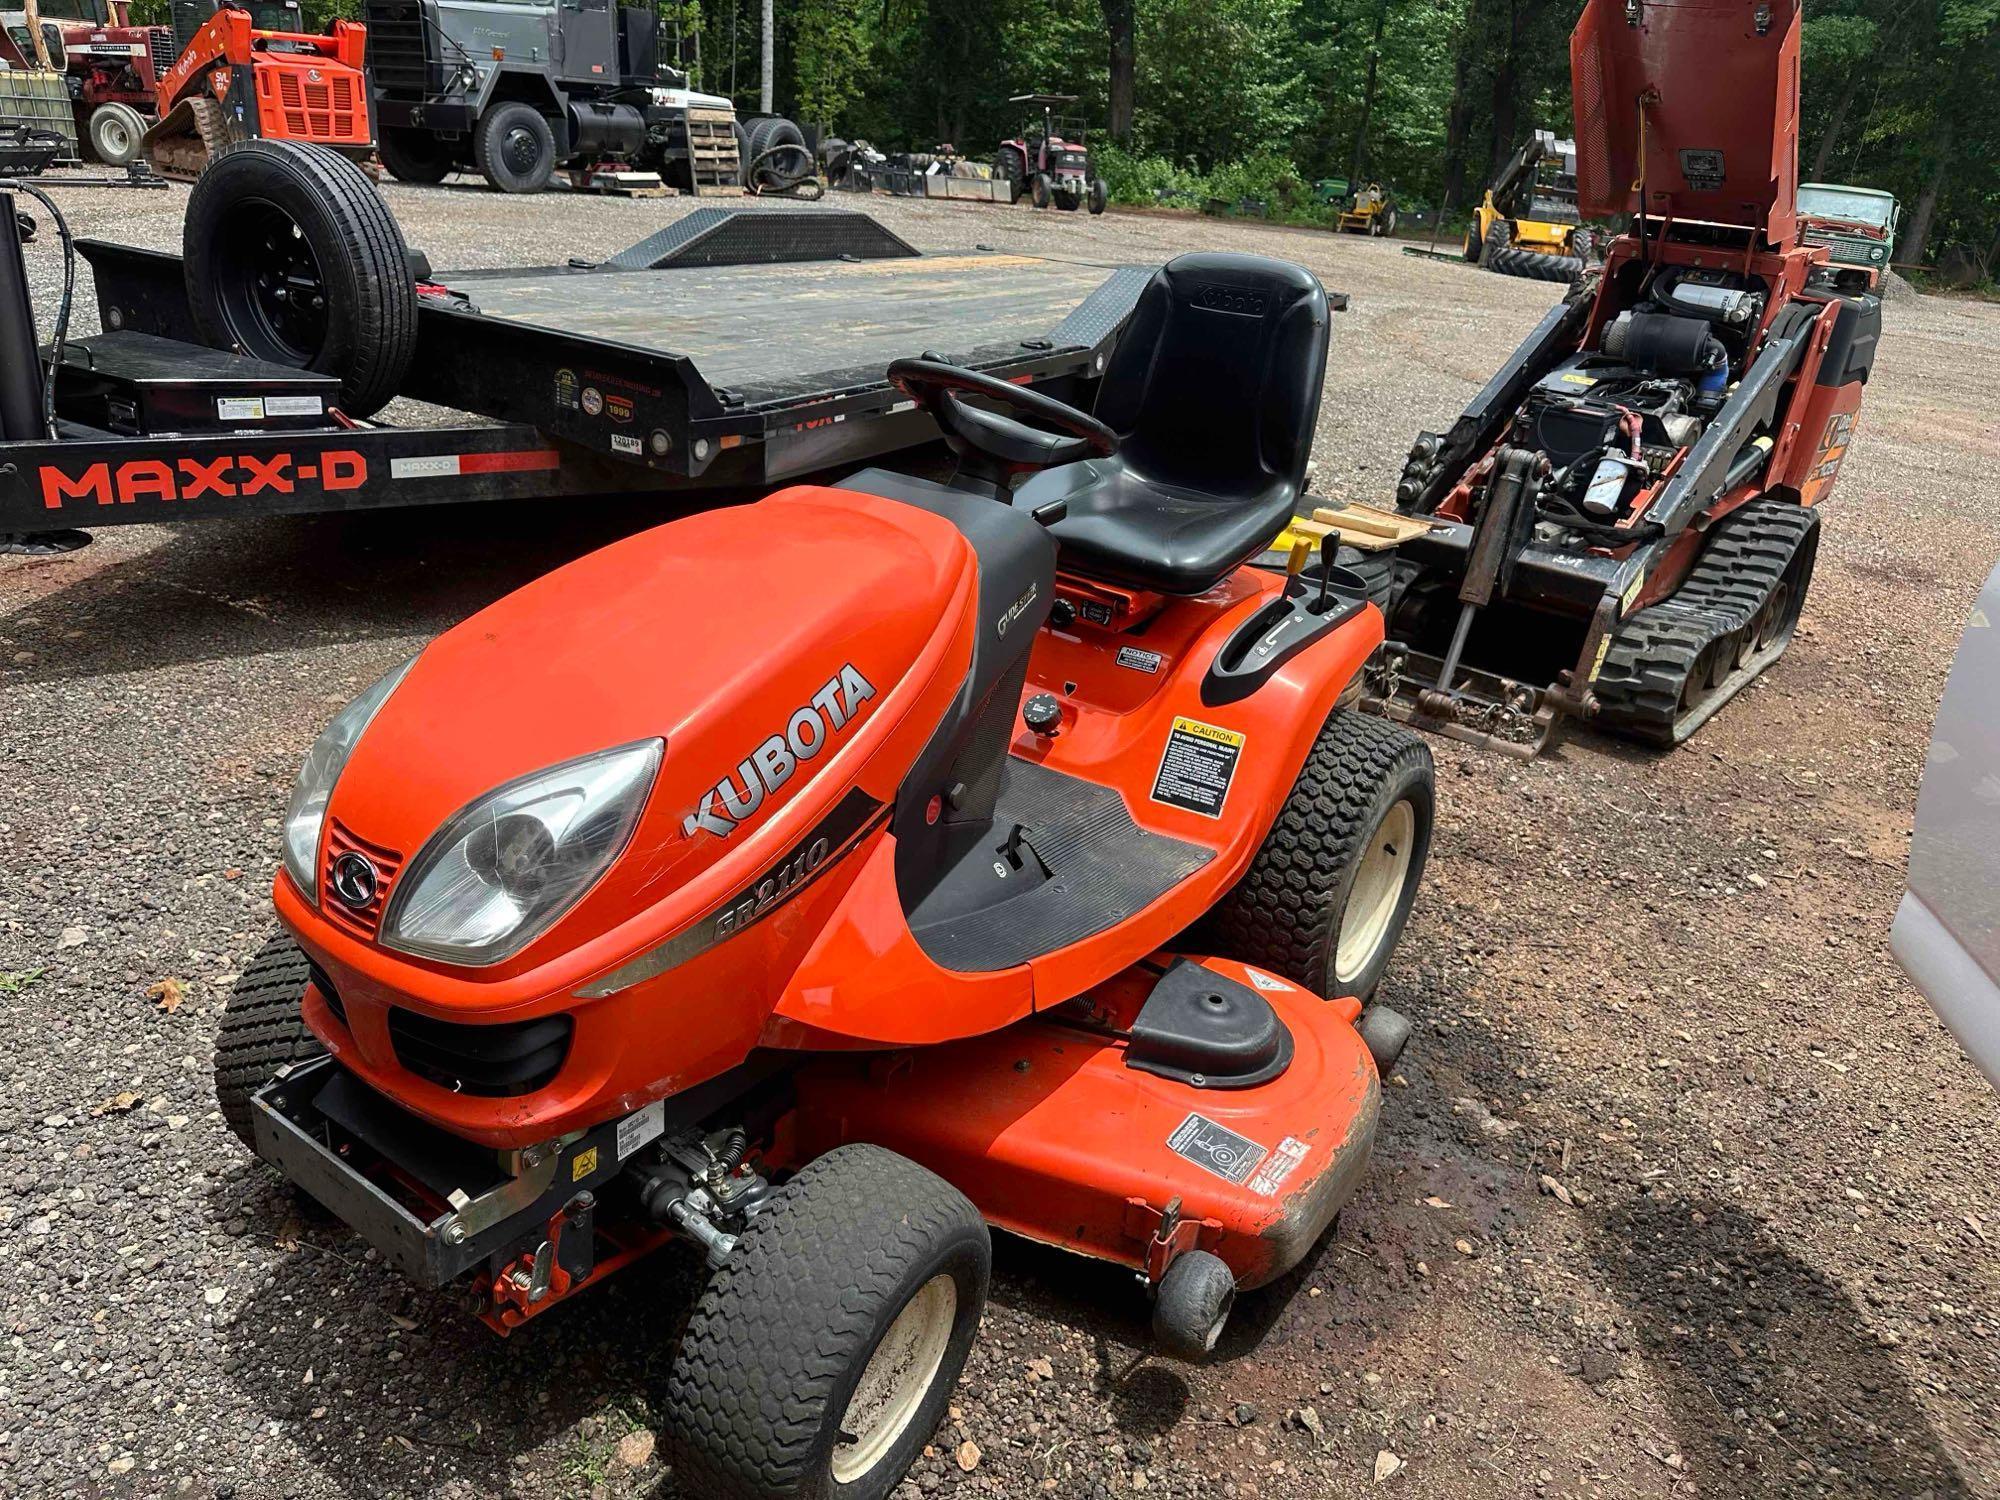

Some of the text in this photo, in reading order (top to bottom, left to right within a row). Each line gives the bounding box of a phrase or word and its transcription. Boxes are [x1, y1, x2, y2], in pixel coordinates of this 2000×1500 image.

[609, 404, 630, 418] 1999
[400, 461, 451, 472] MAXX-D
[39, 450, 367, 509] MAXX-D
[1126, 649, 1157, 659] NOTICE
[1192, 725, 1233, 742] CAUTION
[681, 663, 877, 838] KUBOTA
[713, 837, 829, 938] GR2110
